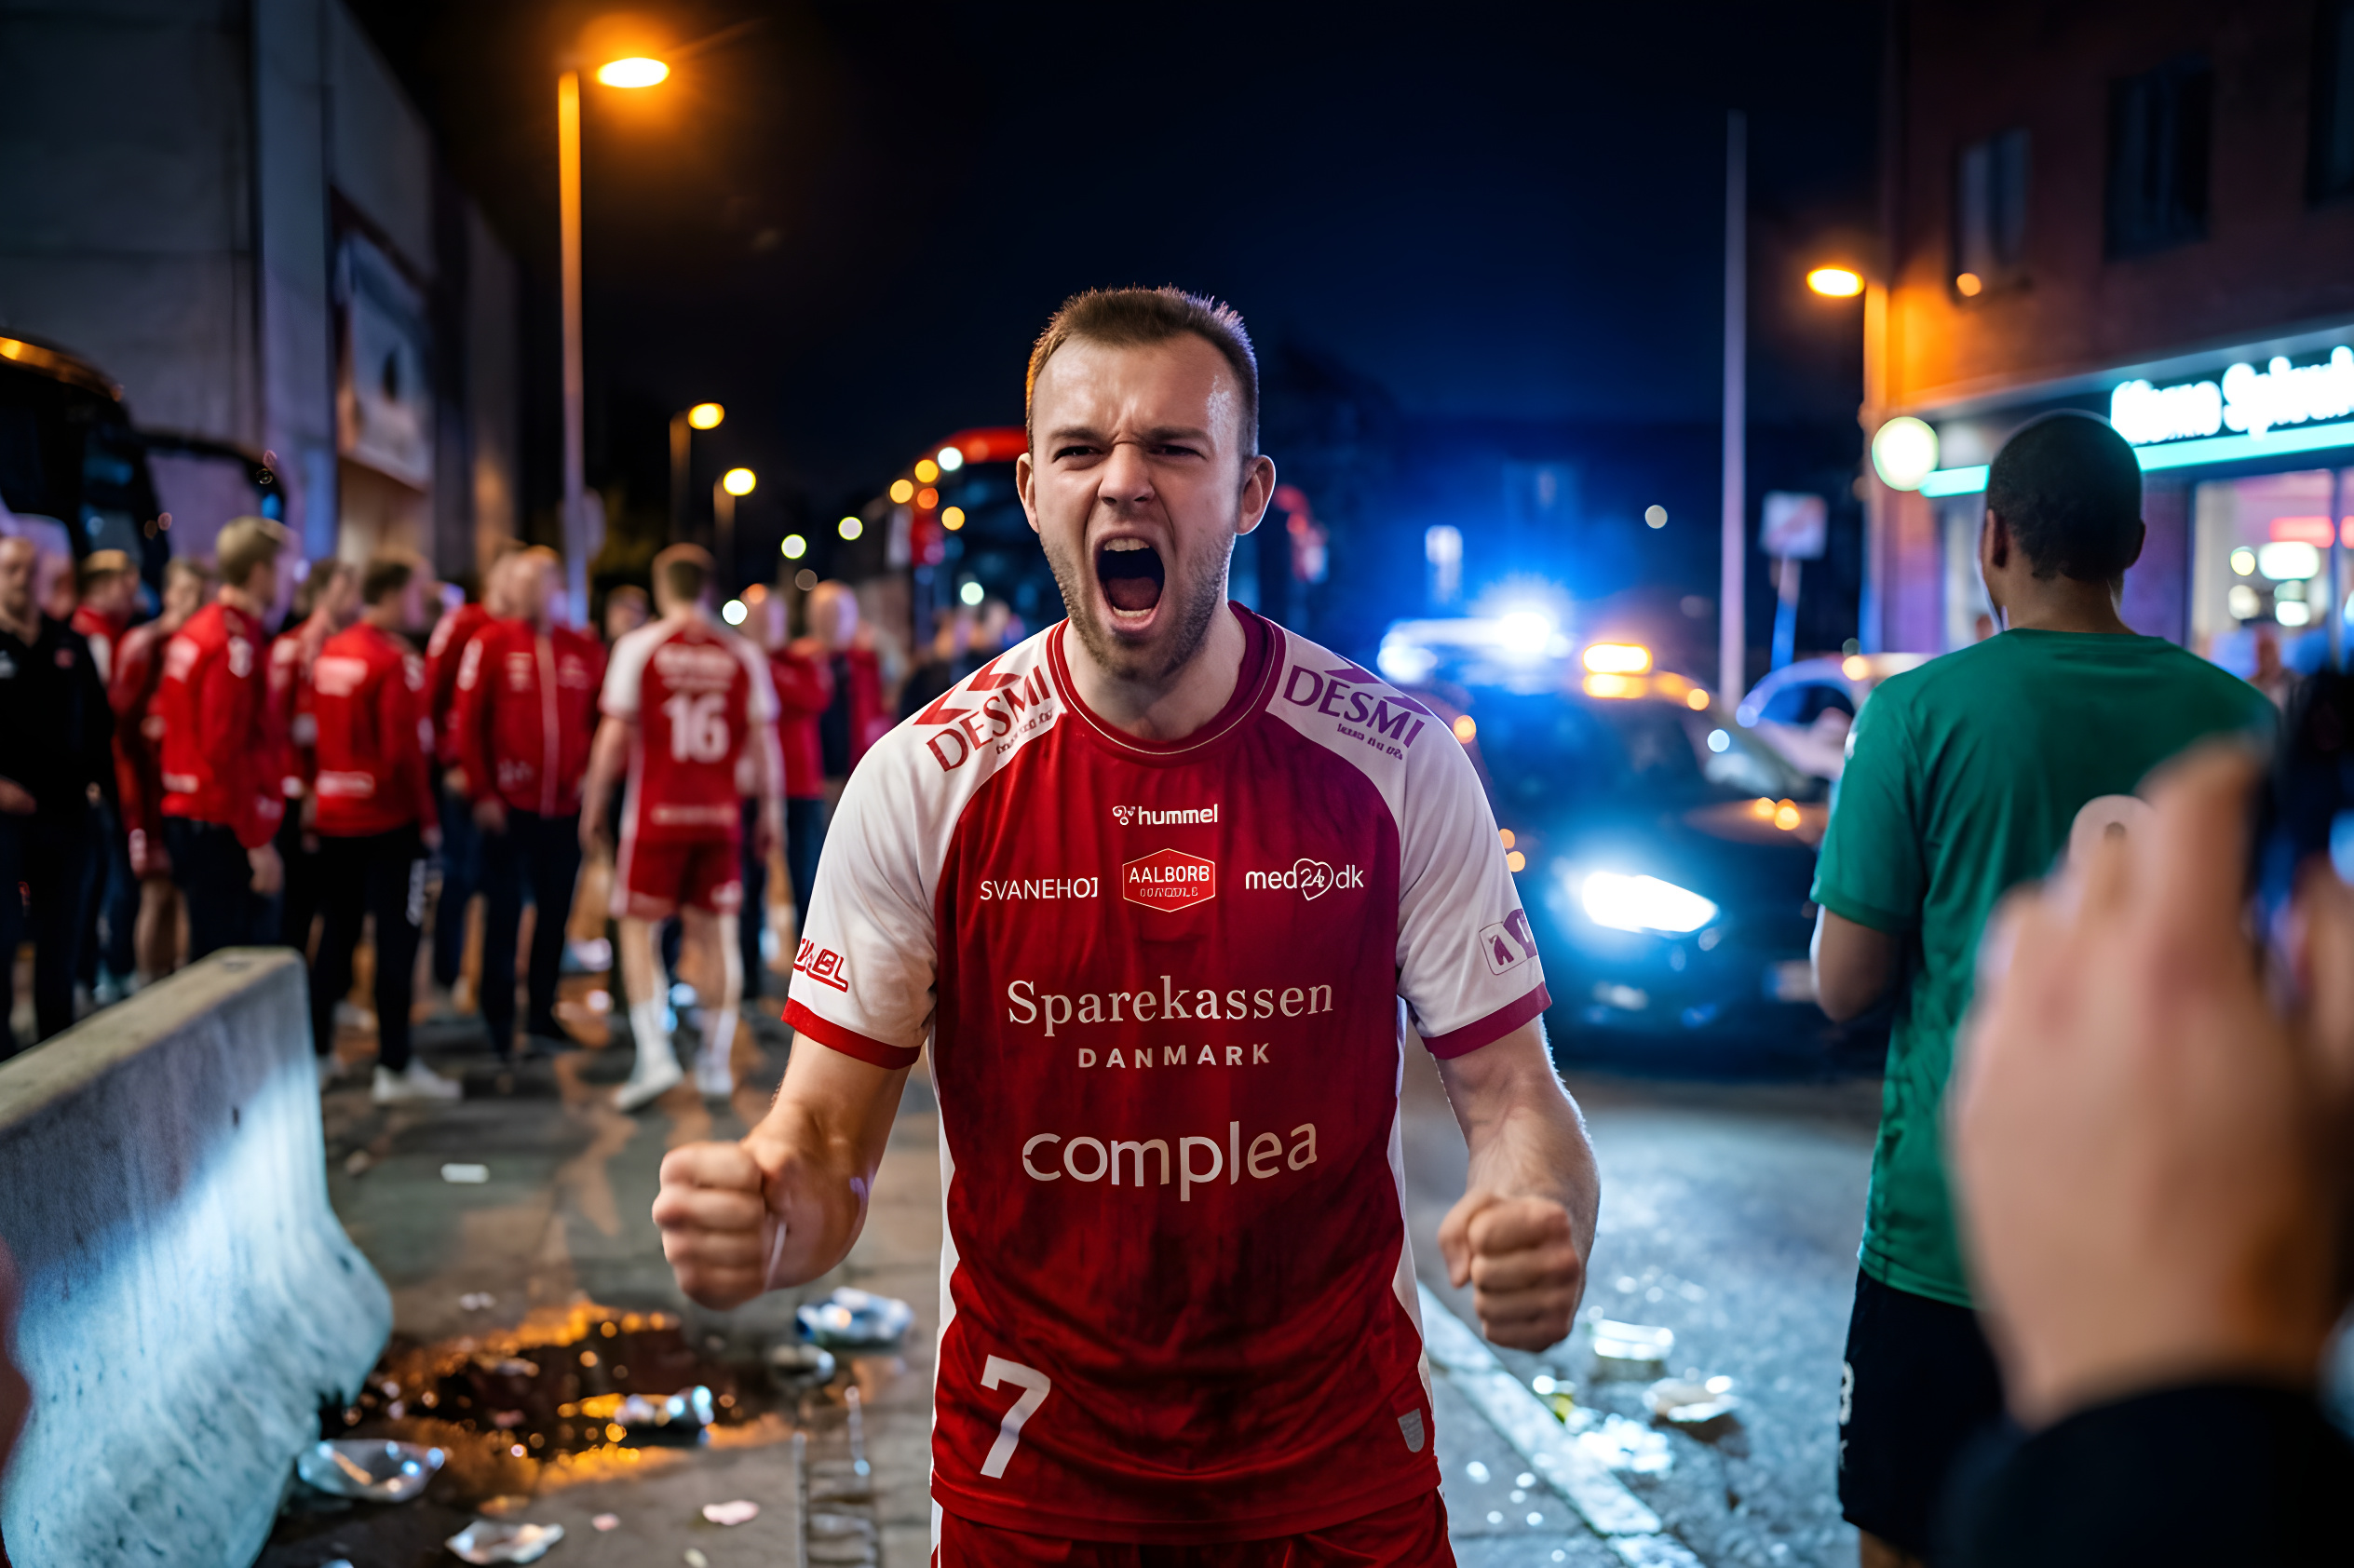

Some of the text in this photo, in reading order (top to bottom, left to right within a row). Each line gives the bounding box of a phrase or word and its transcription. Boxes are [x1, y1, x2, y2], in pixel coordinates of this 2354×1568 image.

[661, 692, 731, 764] 16
[927, 665, 1051, 772] DESMI
[1283, 664, 1426, 748] DESMI
[1138, 804, 1218, 825] hummel
[1008, 975, 1333, 1036] Sparekassen
[1078, 1043, 1270, 1069] DANMARK
[1022, 1121, 1318, 1202] complea
[980, 1354, 1051, 1479] 7
